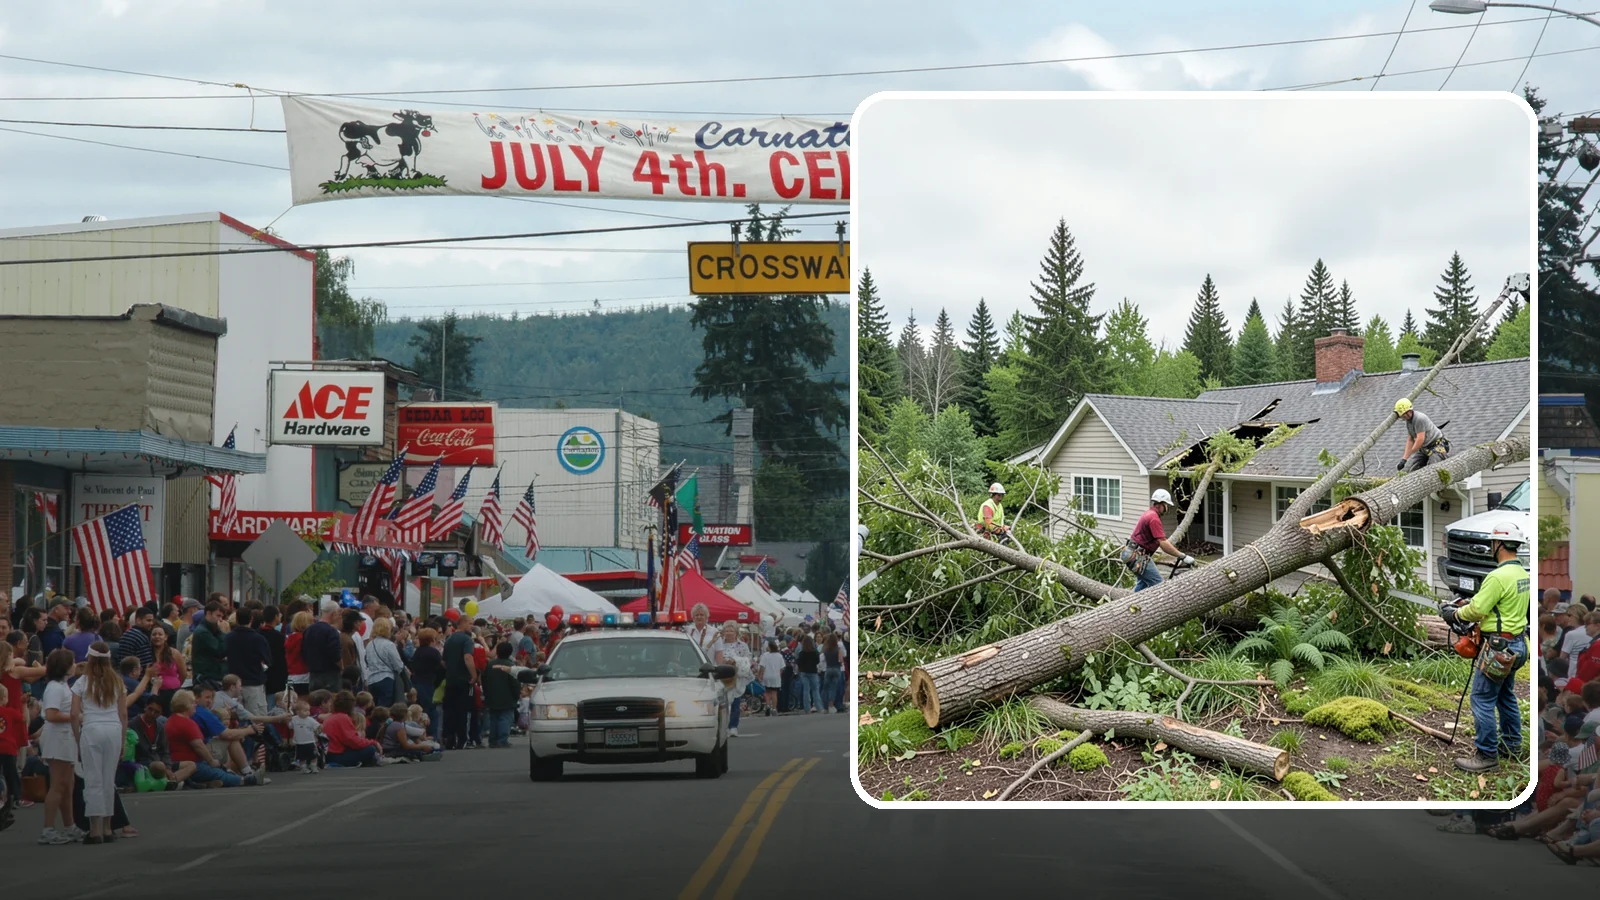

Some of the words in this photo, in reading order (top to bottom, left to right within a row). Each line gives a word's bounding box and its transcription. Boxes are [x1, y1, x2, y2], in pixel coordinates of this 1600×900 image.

[481, 140, 605, 192] JULY
[632, 150, 746, 198] 4th.
[697, 254, 850, 280] CROSSWA
[283, 380, 373, 419] ACE
[406, 410, 453, 421] CEDAR
[283, 421, 371, 436] Hardware
[416, 428, 477, 446] Coca-Cola
[353, 467, 388, 480] Simpl
[83, 485, 93, 494] St.
[96, 485, 124, 494] Vincent
[126, 486, 136, 494] de
[138, 486, 155, 495] Paul
[213, 516, 331, 535] HARDARE
[688, 526, 741, 535] CRNATION
[700, 535, 730, 543] GLASS
